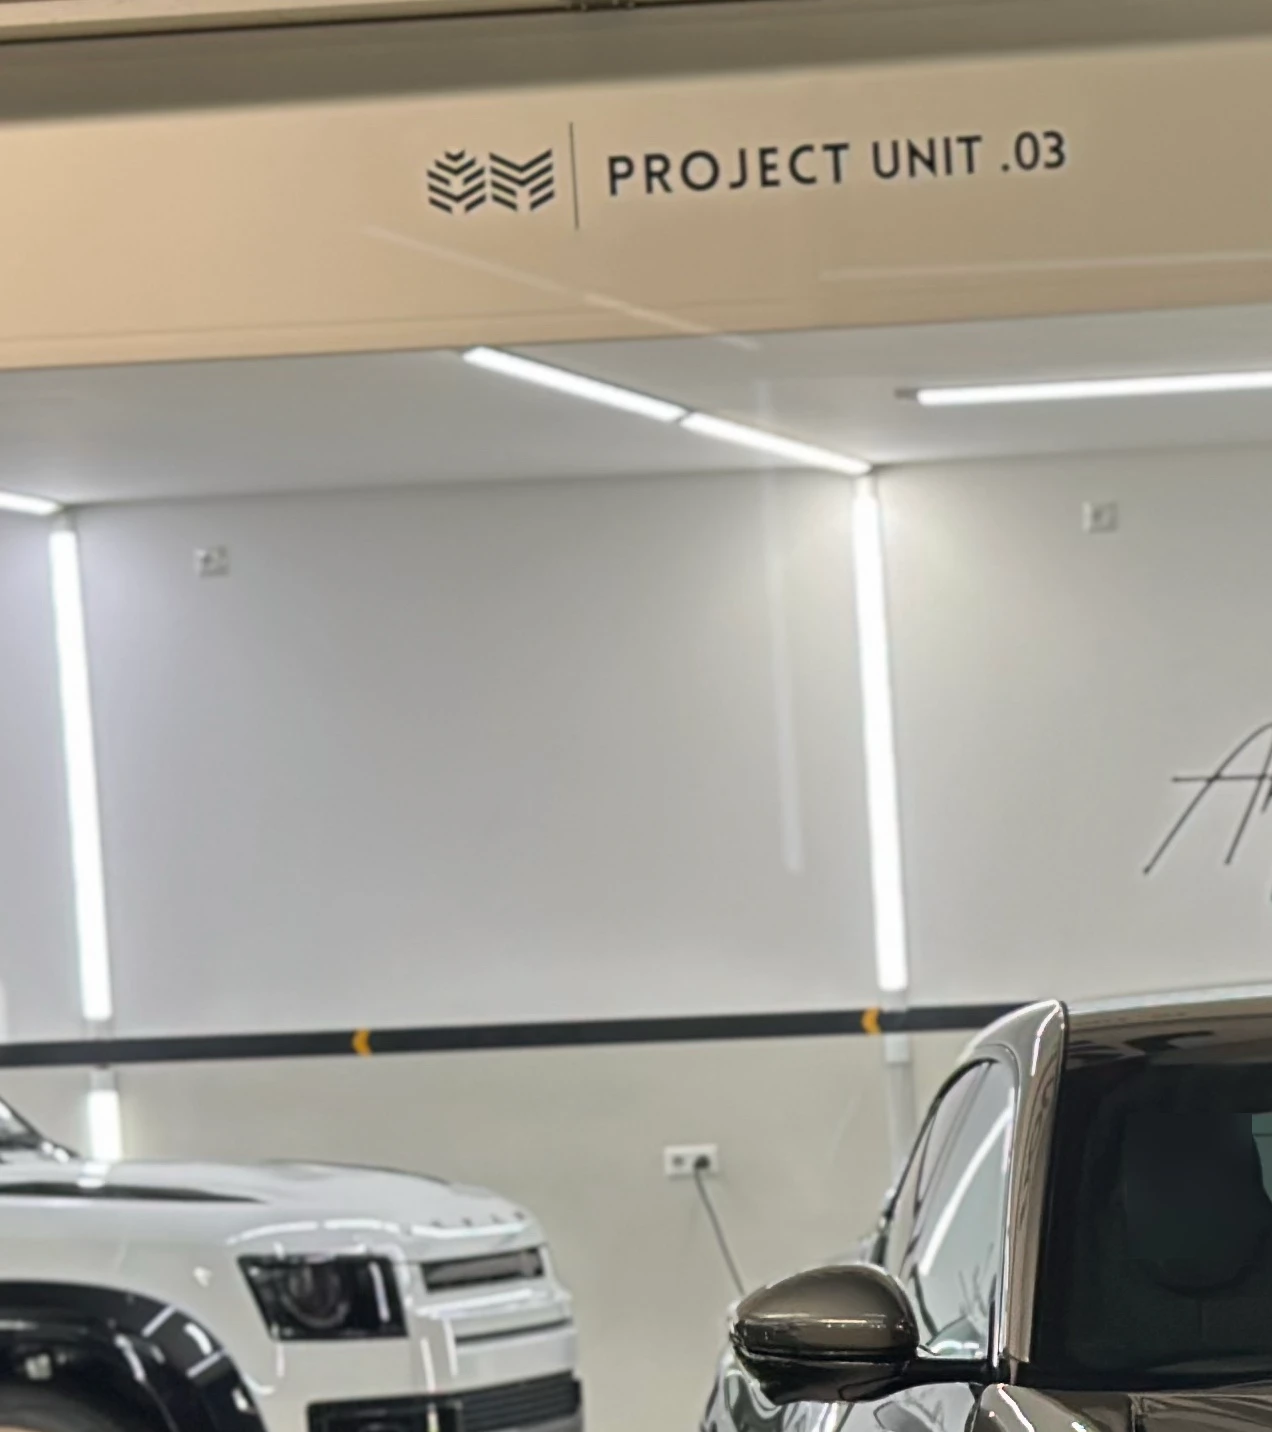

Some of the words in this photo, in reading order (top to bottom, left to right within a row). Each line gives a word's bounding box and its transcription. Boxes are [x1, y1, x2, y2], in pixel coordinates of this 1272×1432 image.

[608, 141, 850, 197] PROJECT
[871, 134, 983, 180] UNIT
[1000, 129, 1067, 173] .03
